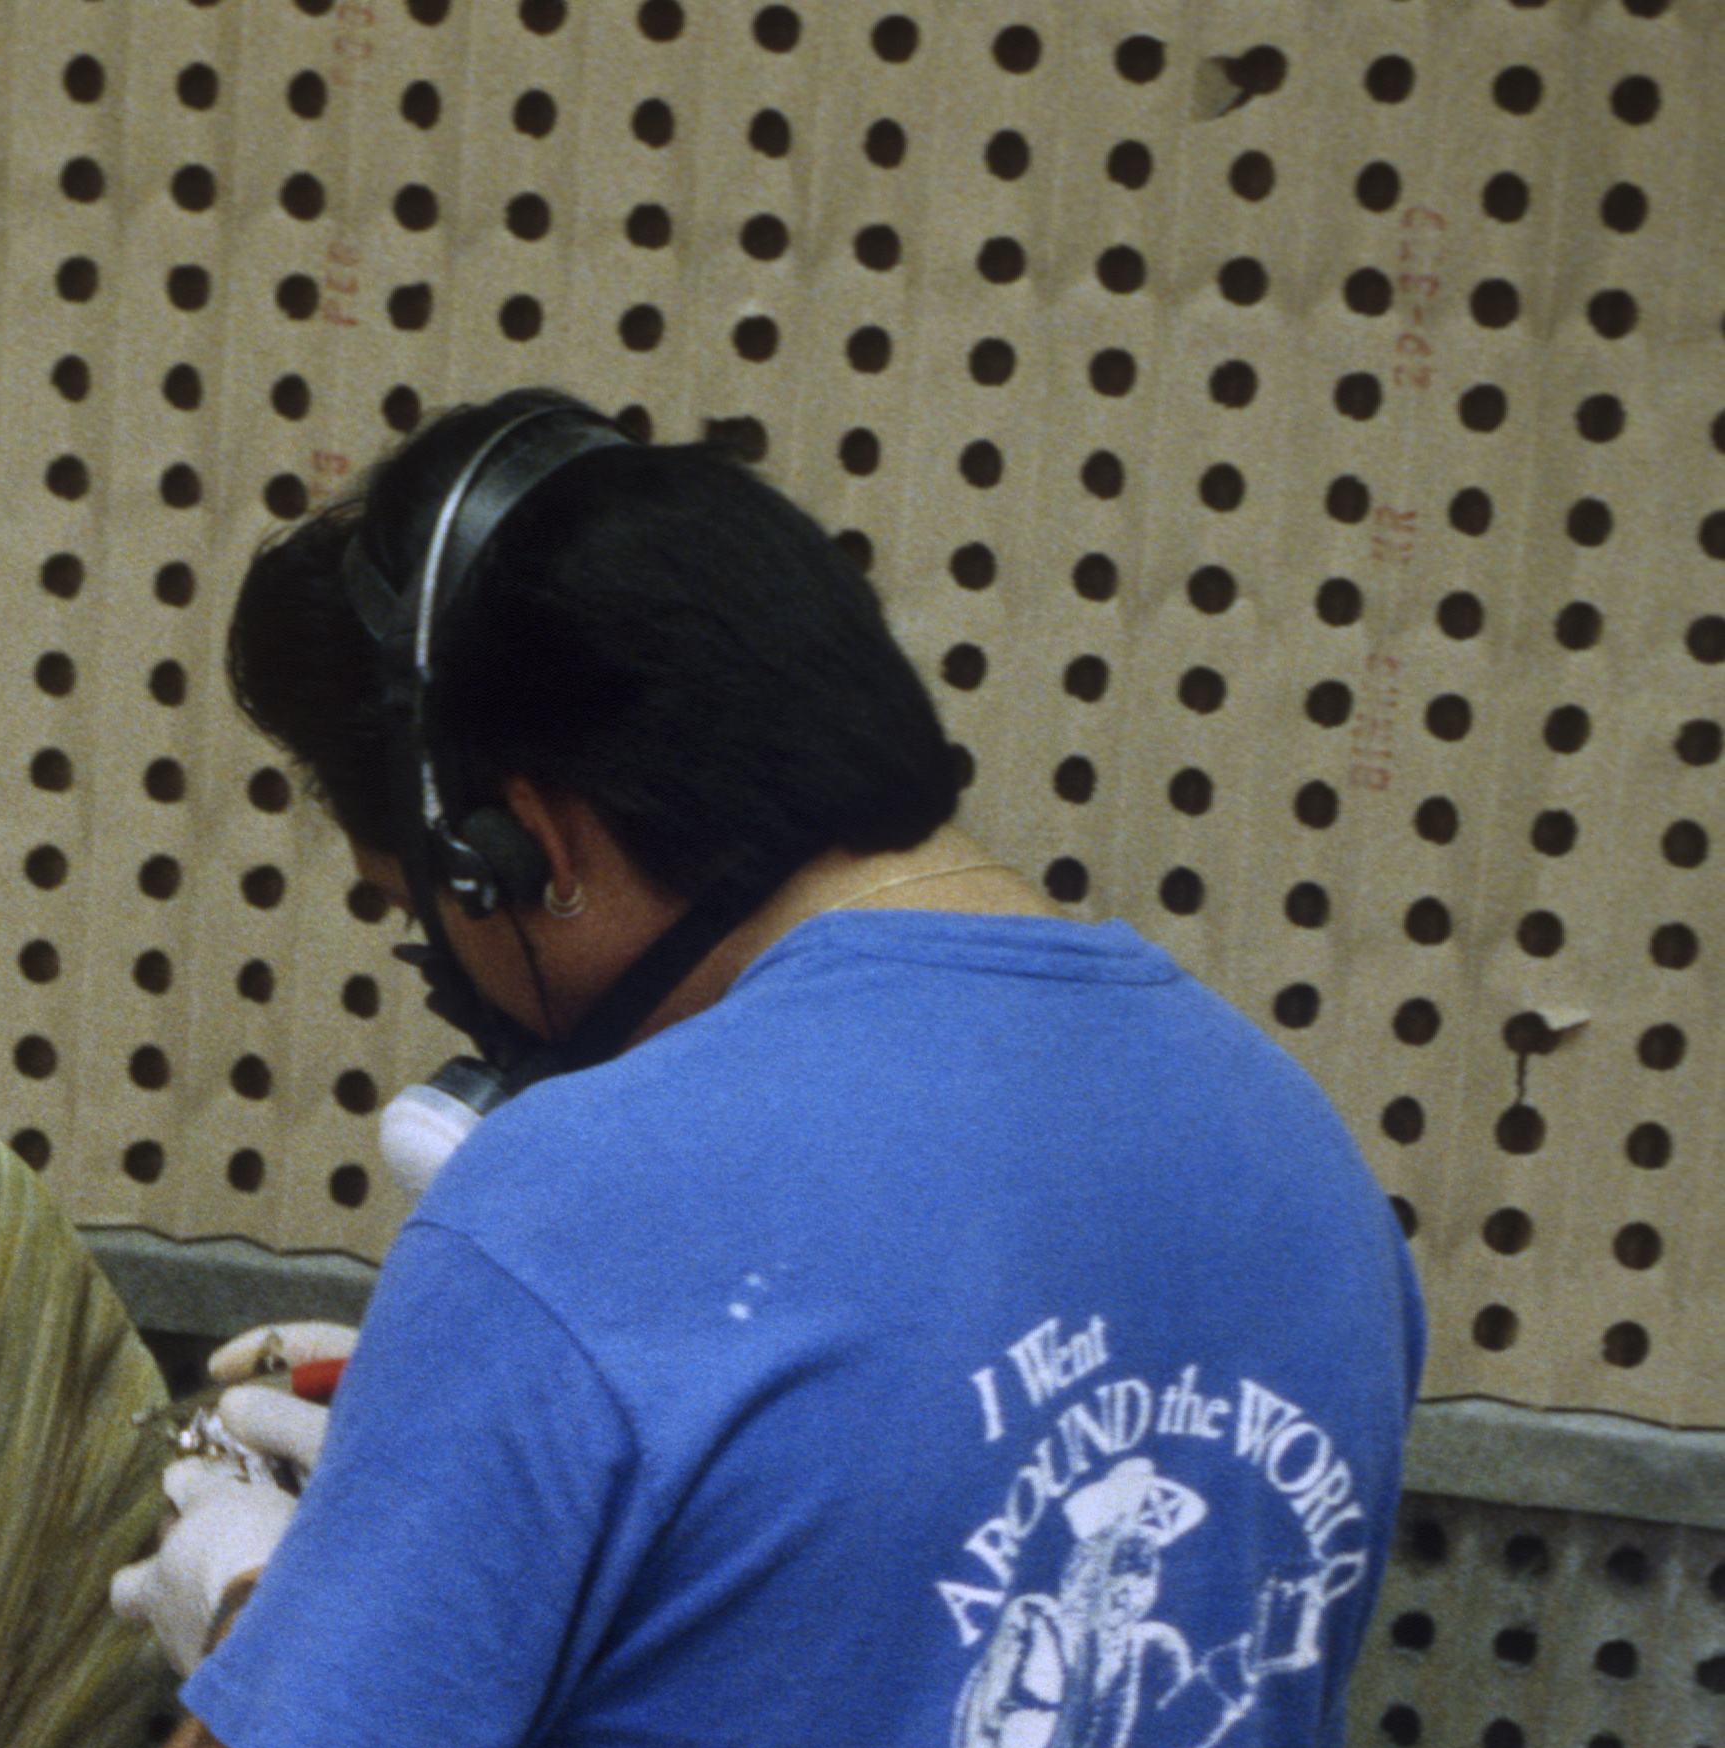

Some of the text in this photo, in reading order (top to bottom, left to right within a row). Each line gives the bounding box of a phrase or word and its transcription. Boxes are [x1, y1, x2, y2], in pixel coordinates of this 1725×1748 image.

[969, 1315, 1110, 1442] I Went
[934, 1364, 1369, 1648] AROUND the WORLD
